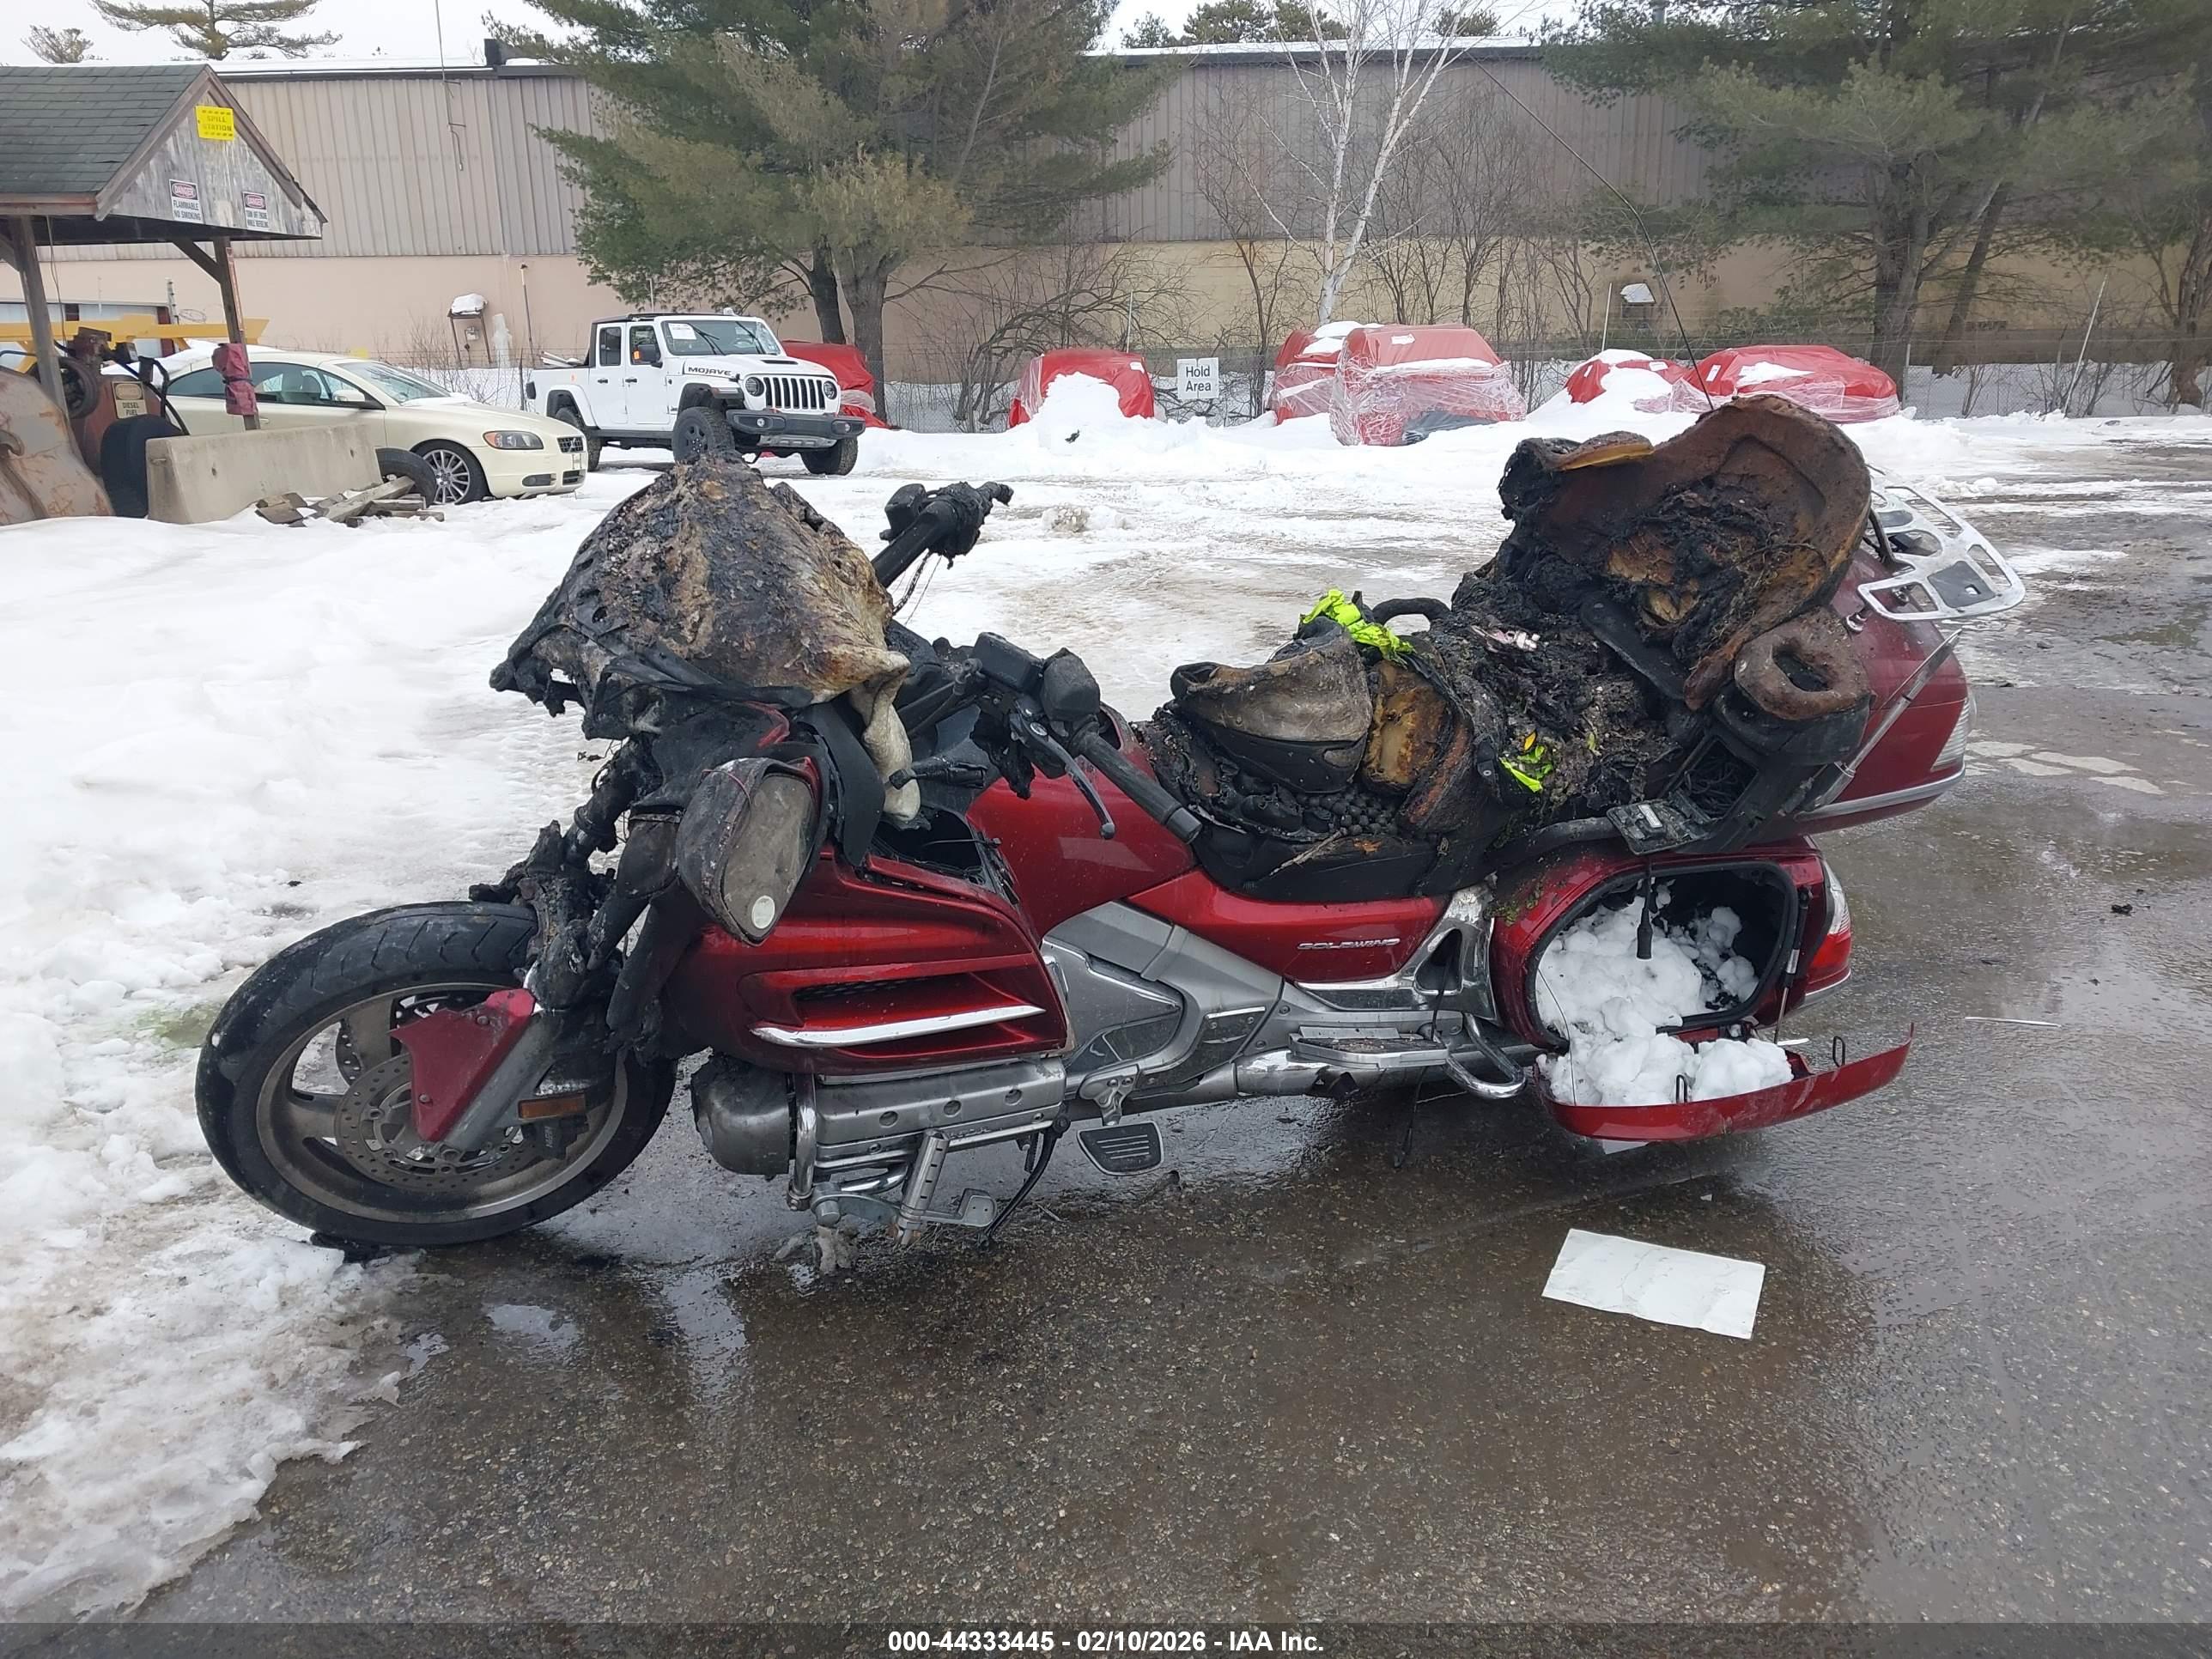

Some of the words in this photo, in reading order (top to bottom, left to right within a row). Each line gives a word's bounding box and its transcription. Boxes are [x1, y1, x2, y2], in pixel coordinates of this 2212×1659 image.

[688, 367, 732, 375] MOJAVE
[1186, 365, 1210, 378] Hold
[1185, 380, 1212, 392] Area
